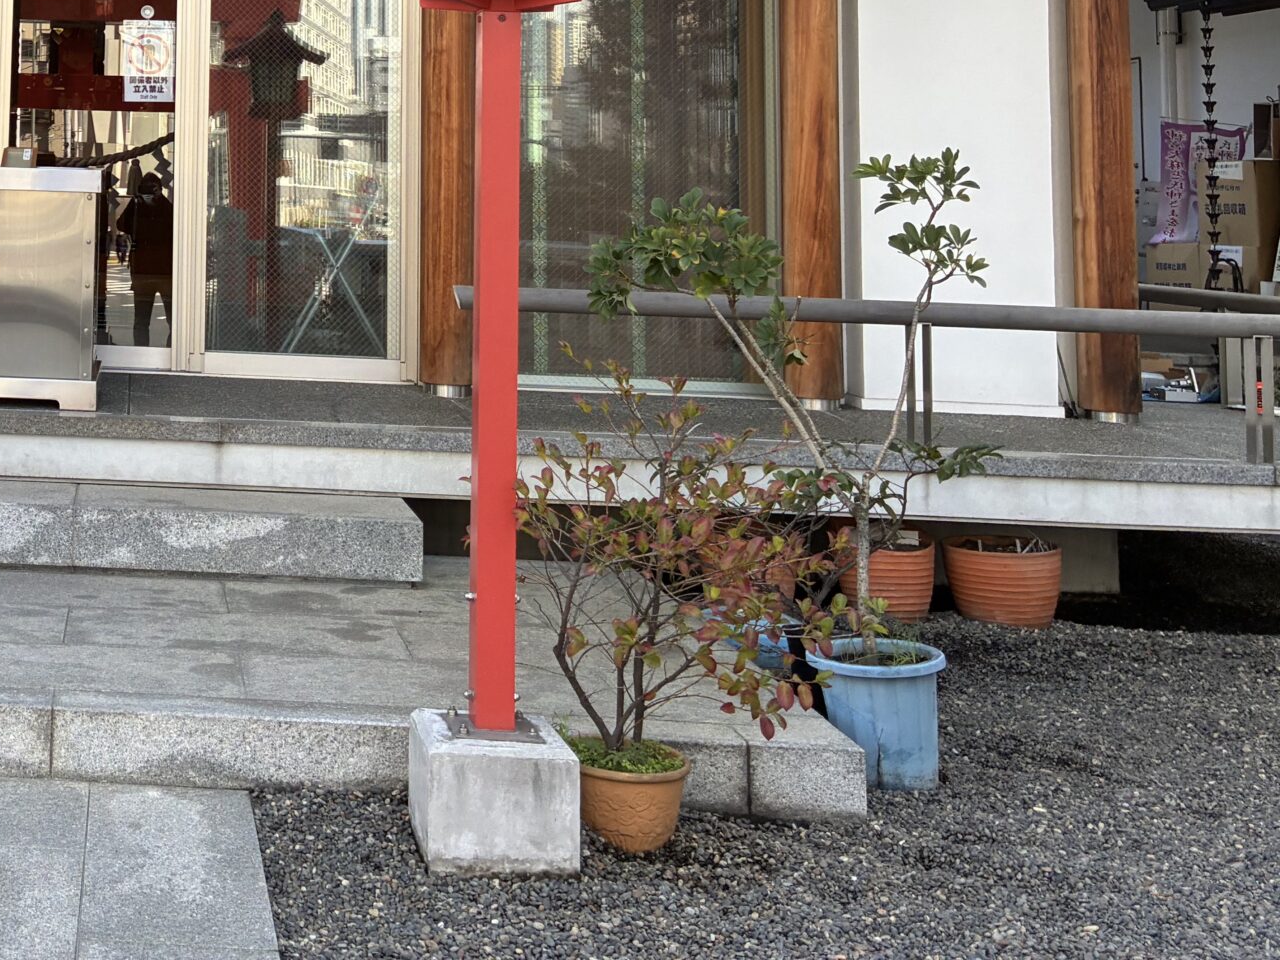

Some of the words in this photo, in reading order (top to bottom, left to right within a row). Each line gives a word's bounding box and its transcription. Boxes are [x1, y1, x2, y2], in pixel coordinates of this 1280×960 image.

[129, 76, 168, 84] 関係者以外
[133, 85, 164, 93] 立入禁止
